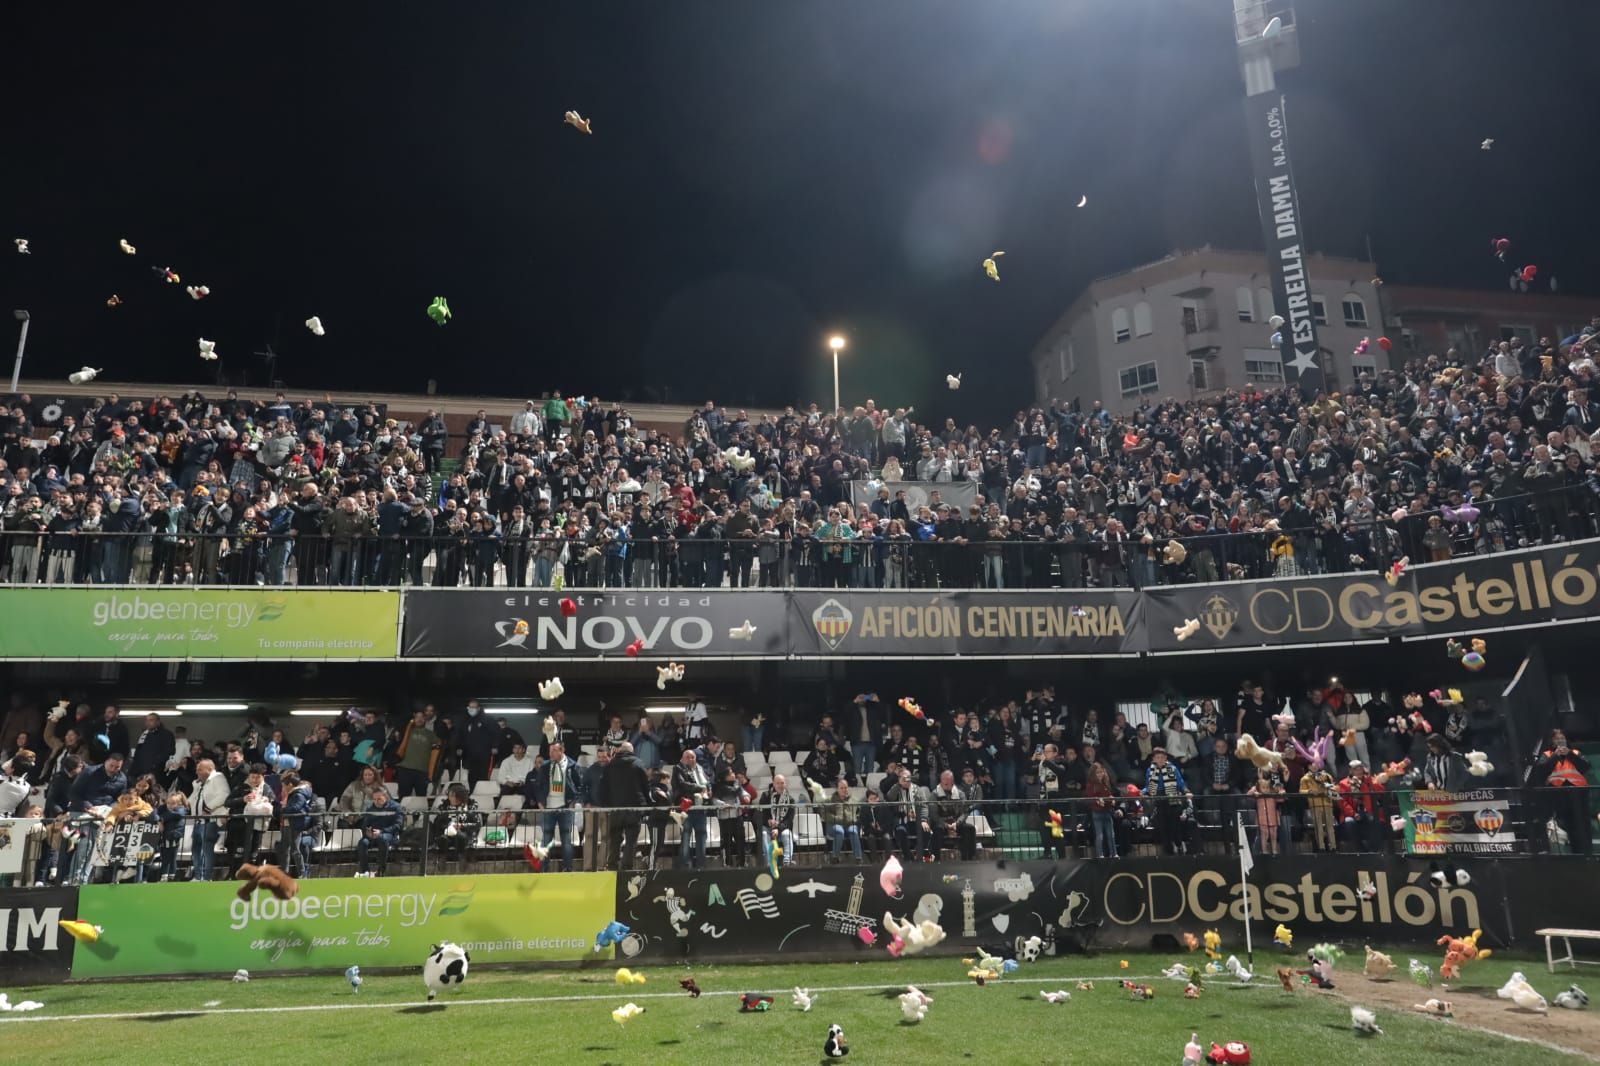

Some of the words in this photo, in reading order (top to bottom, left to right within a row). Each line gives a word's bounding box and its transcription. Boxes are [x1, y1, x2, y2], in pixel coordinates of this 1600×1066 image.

[1271, 138, 1287, 167] N.A.
[1269, 174, 1297, 240] DAMM
[1280, 244, 1314, 345] ESTRELLA
[93, 596, 257, 628] globeenergy
[504, 594, 711, 607] eletricidad
[536, 616, 713, 650] NOVO
[860, 600, 961, 637] AFICIÓN
[967, 605, 1126, 637] CENTENARIA
[152, 632, 186, 646] para
[188, 625, 219, 641] todos
[258, 638, 271, 648] Tu
[250, 930, 304, 962] energía
[307, 935, 350, 955] para
[352, 924, 391, 947] todos
[460, 939, 523, 953] compañía
[527, 937, 585, 950] eléctrica
